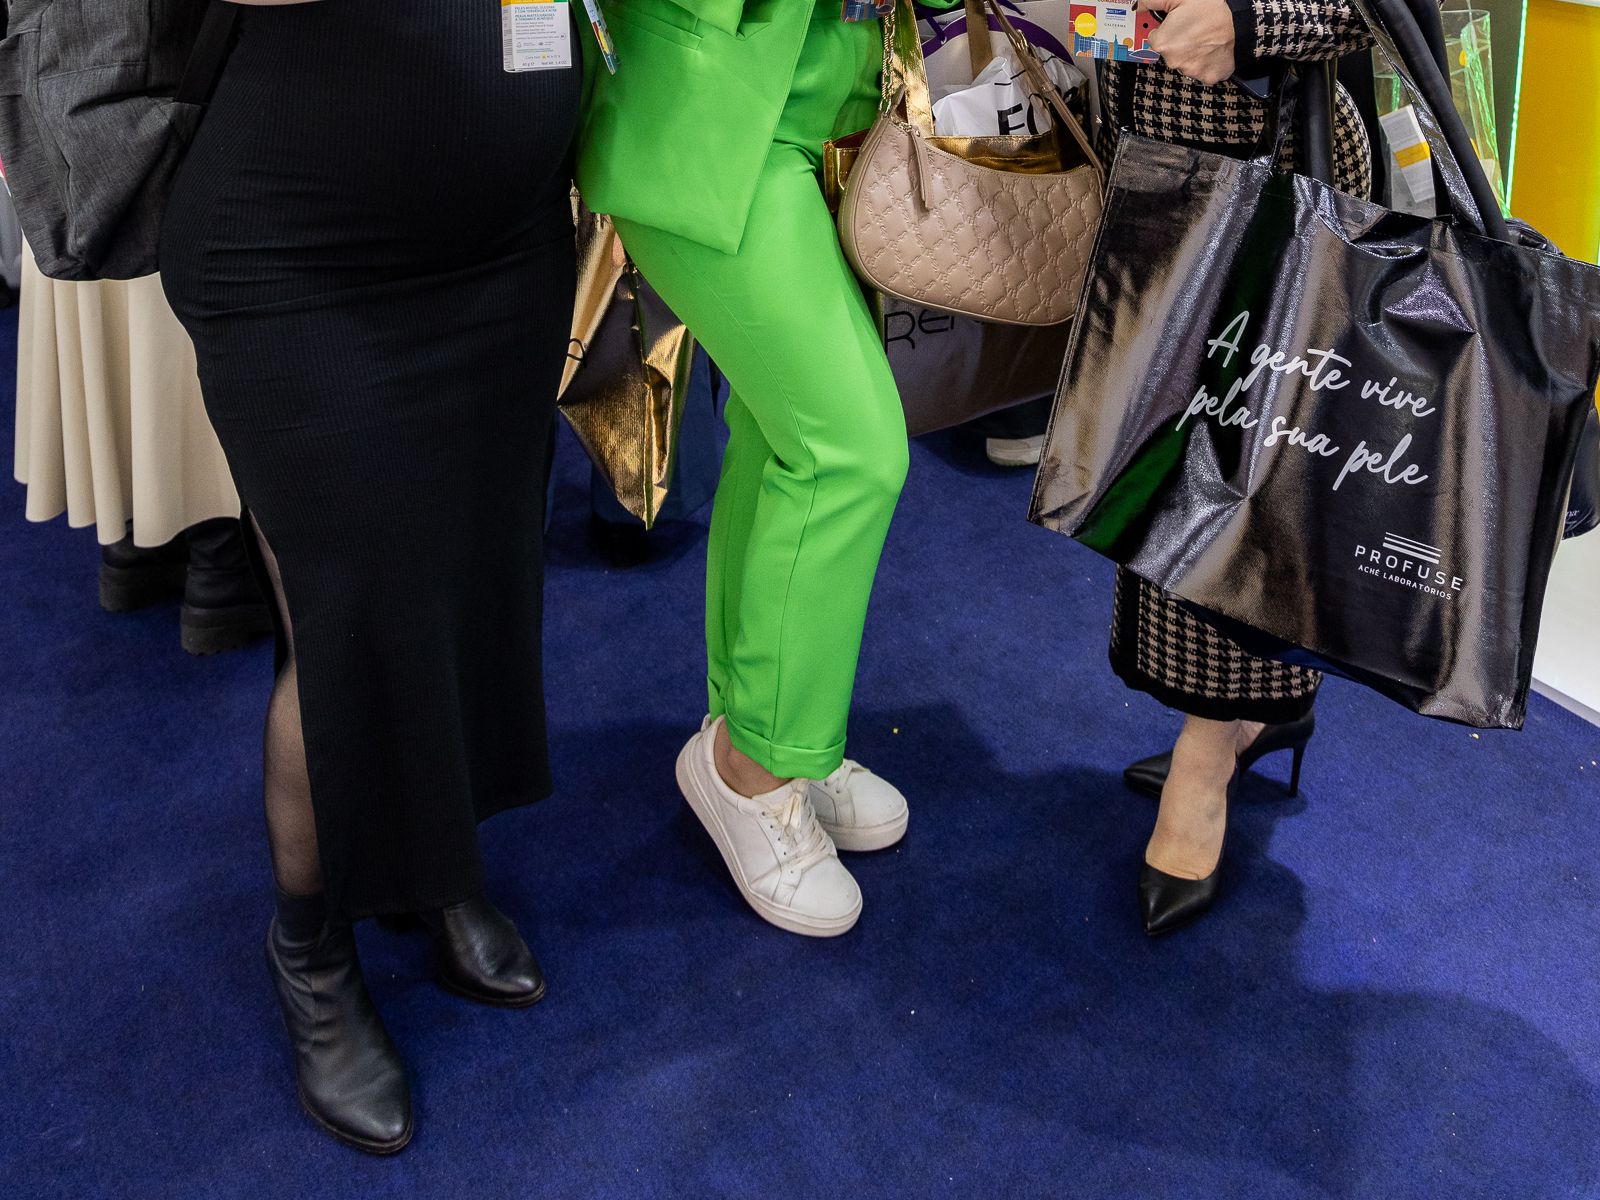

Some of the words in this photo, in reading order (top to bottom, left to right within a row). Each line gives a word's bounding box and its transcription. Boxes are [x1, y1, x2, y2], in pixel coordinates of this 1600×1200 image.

[1207, 311, 1249, 368] A
[1241, 343, 1353, 392] gente
[1360, 377, 1436, 417] vive
[1175, 377, 1259, 431] pela
[1263, 415, 1340, 457] sua
[1332, 433, 1429, 491] pele
[1354, 544, 1463, 591] PROFUSE
